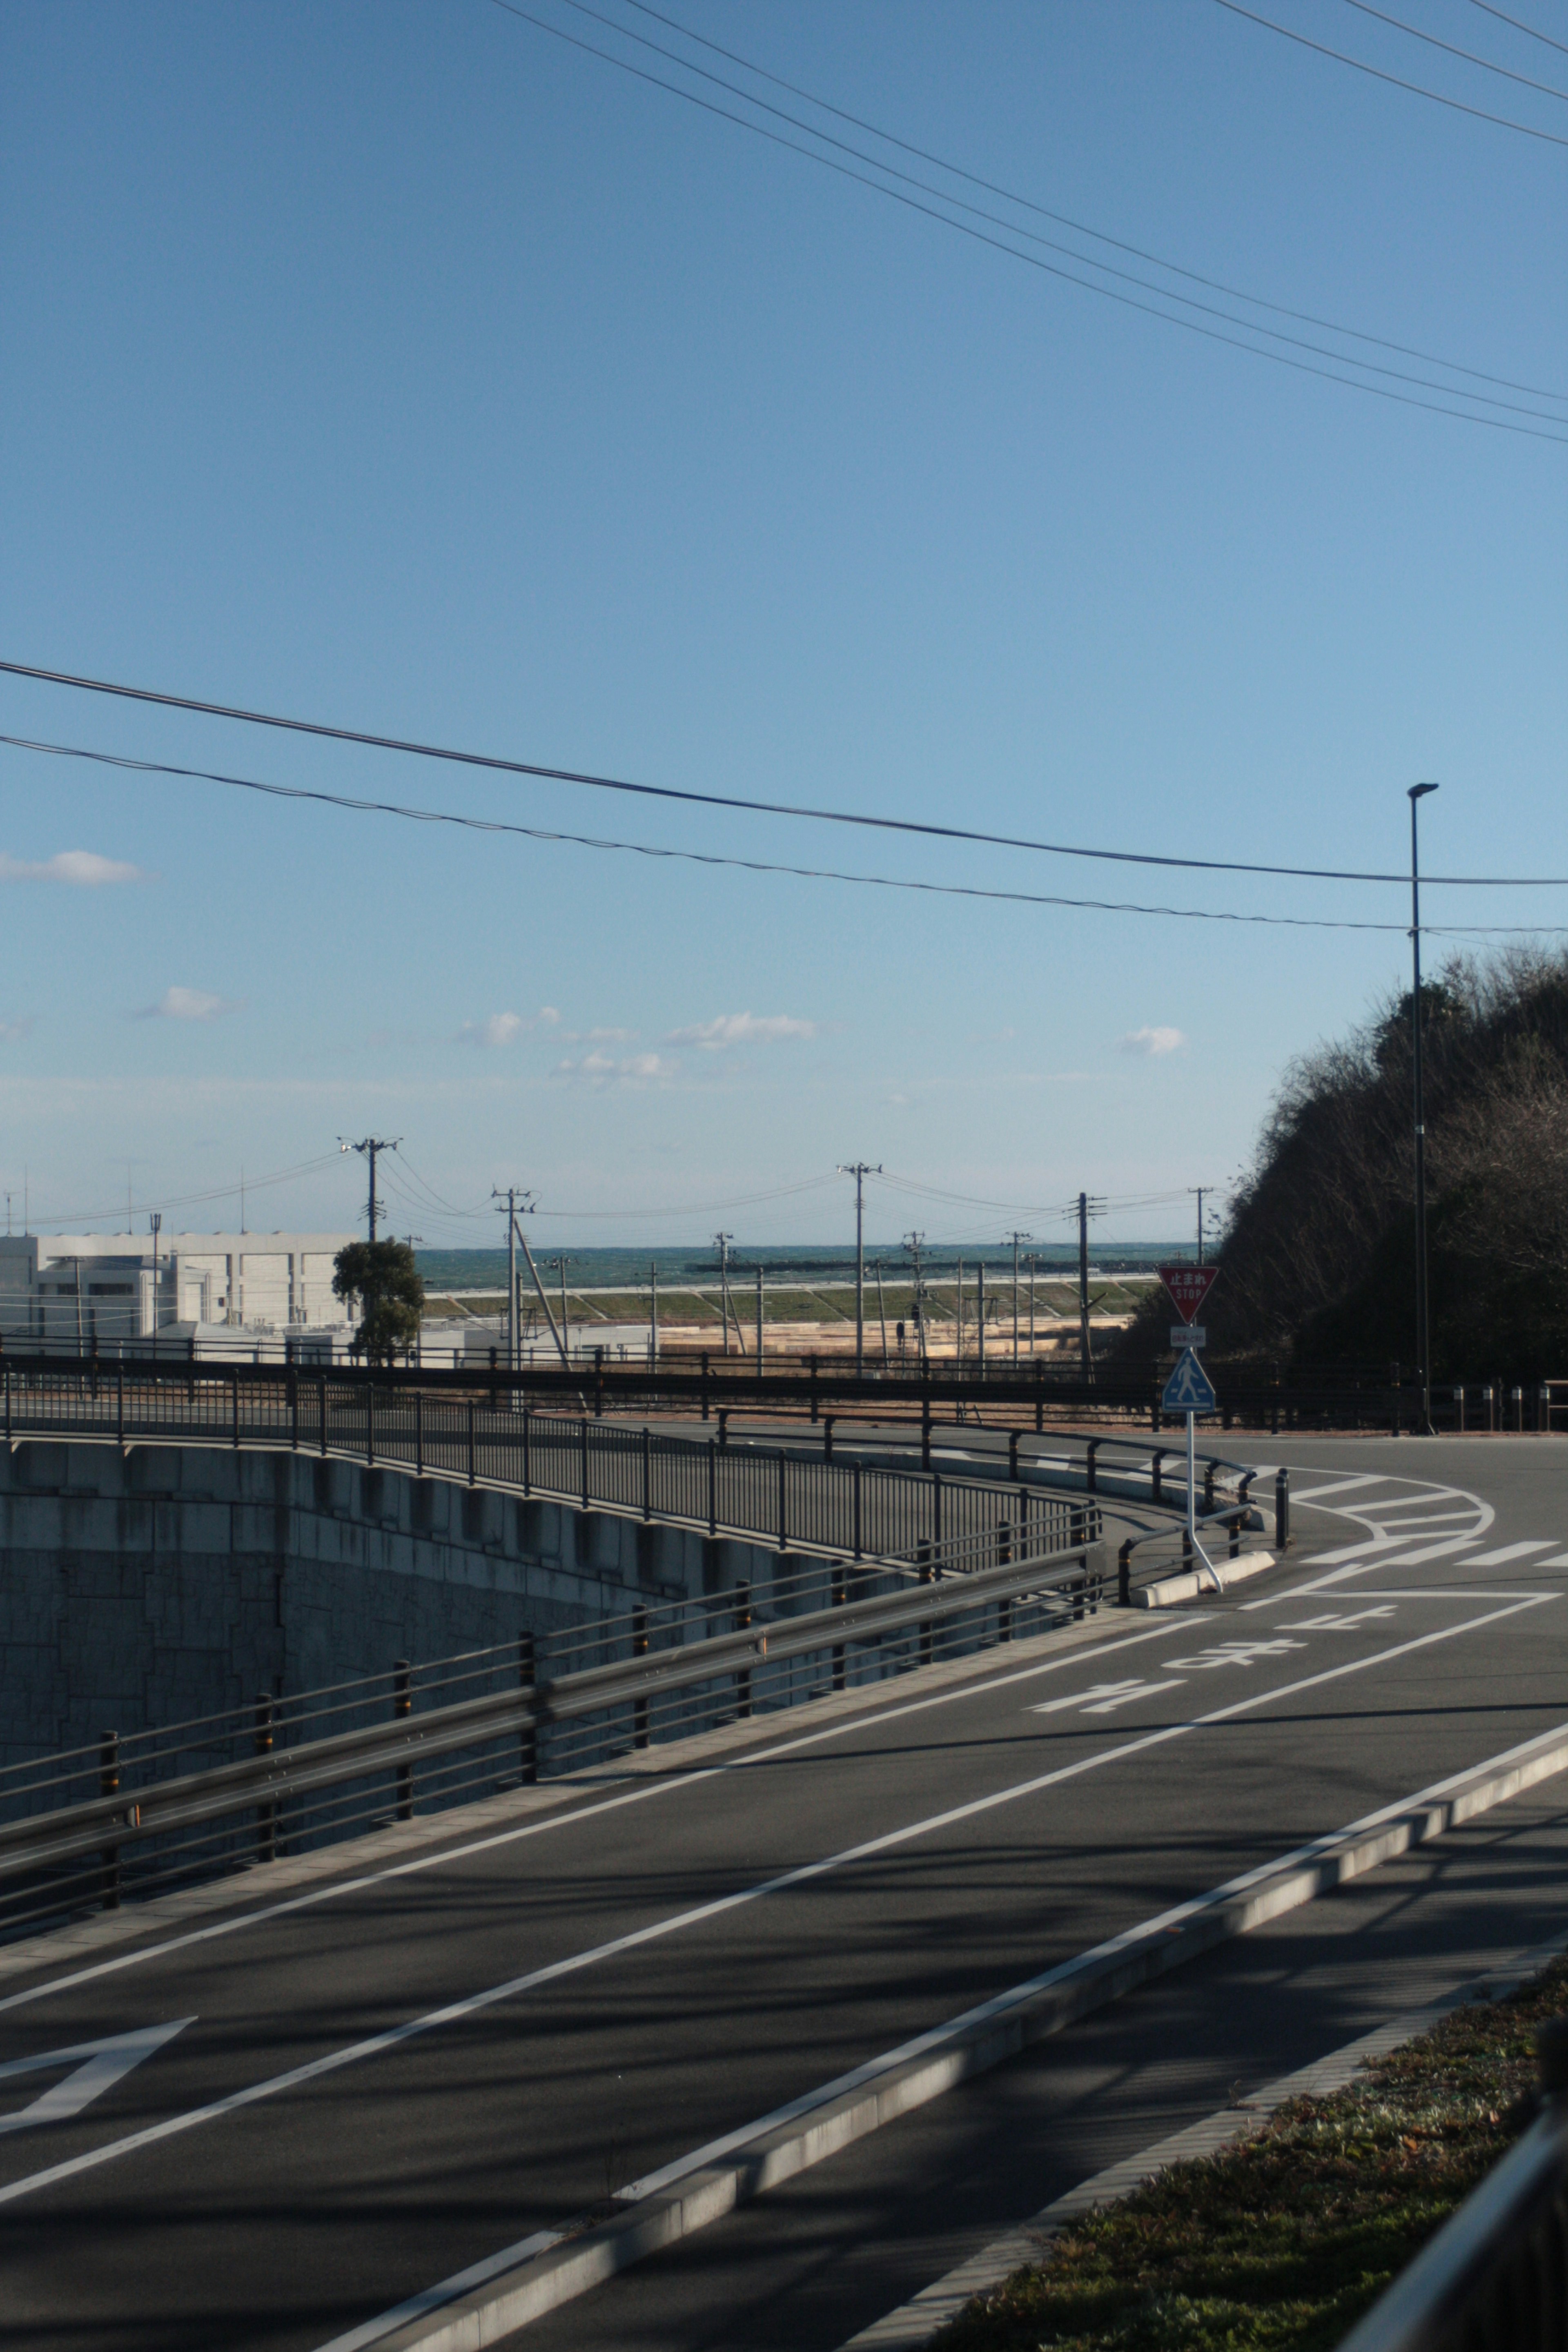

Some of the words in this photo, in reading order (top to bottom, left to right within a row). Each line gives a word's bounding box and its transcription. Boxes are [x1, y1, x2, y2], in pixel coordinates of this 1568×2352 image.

[1170, 1273, 1206, 1285] 止まれ
[1177, 1289, 1201, 1299] STOP
[1020, 1605, 1398, 1712] 止まれ
